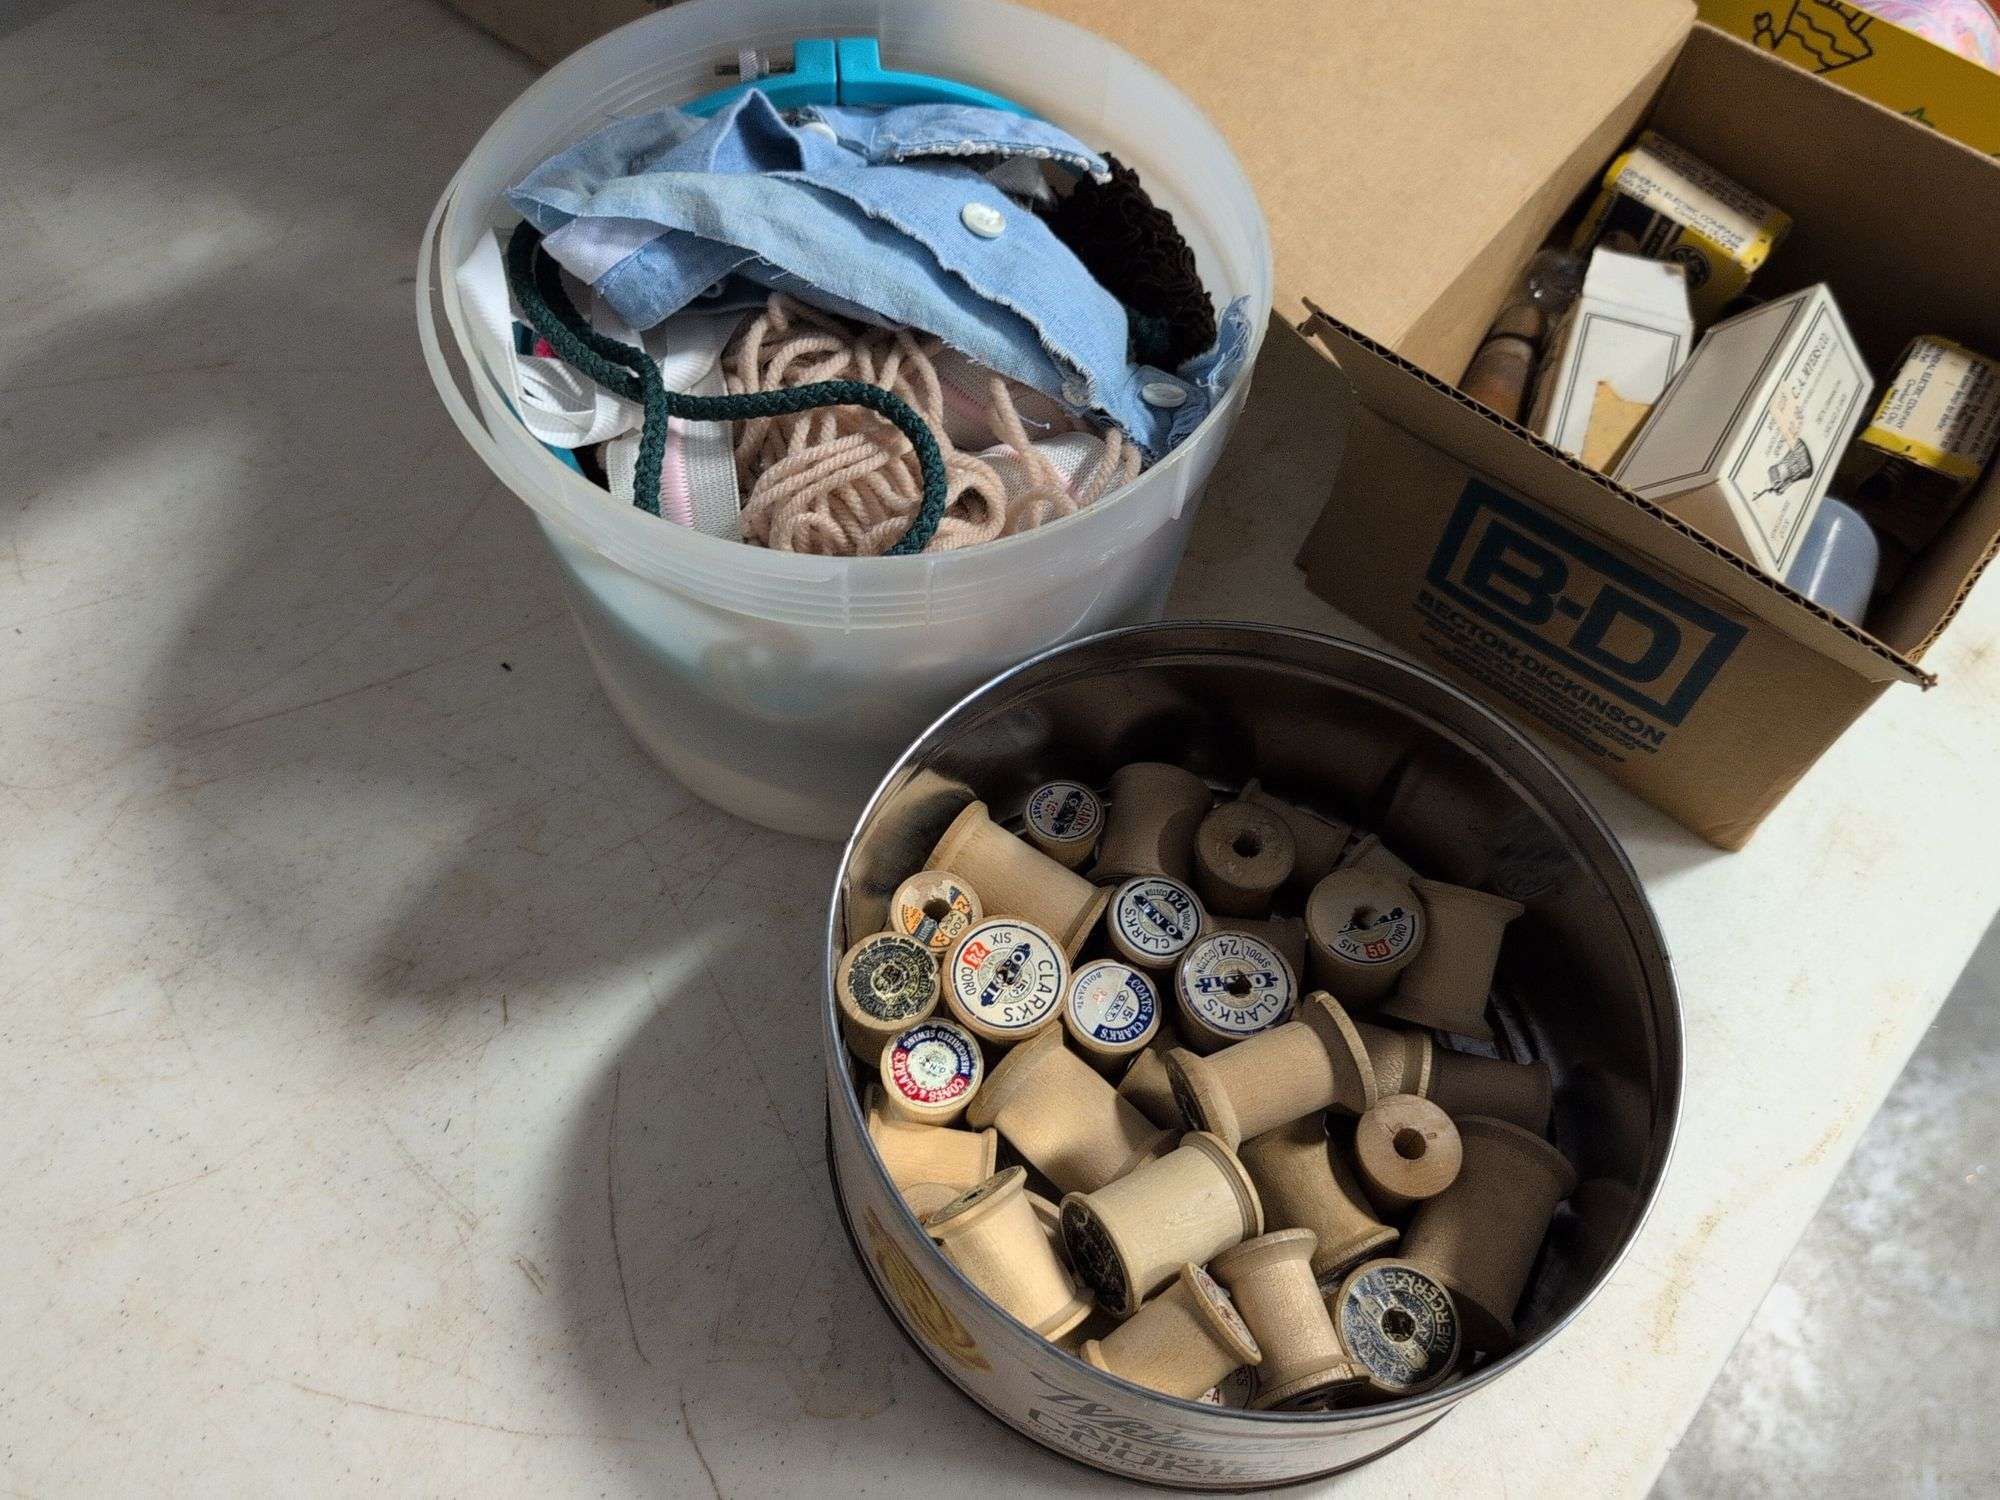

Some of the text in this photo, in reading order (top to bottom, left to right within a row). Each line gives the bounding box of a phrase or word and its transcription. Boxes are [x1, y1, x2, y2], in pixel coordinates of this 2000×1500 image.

[1461, 515, 1682, 683] B-D
[1169, 891, 1185, 910] 24
[991, 932, 1012, 945] SIX
[1125, 907, 1170, 950] CLARK'S
[1339, 939, 1360, 954] SIX
[1389, 923, 1407, 947] CORD
[1218, 939, 1239, 956] 24
[1244, 945, 1271, 969] SPOOL
[960, 966, 977, 996] CORD
[1005, 959, 1053, 1022] CLARK'S
[1131, 978, 1153, 1015] COATS
[1203, 993, 1279, 1025] CLARK'S
[1101, 1022, 1145, 1043] CLARK'S
[928, 1076, 965, 1102] COATS
